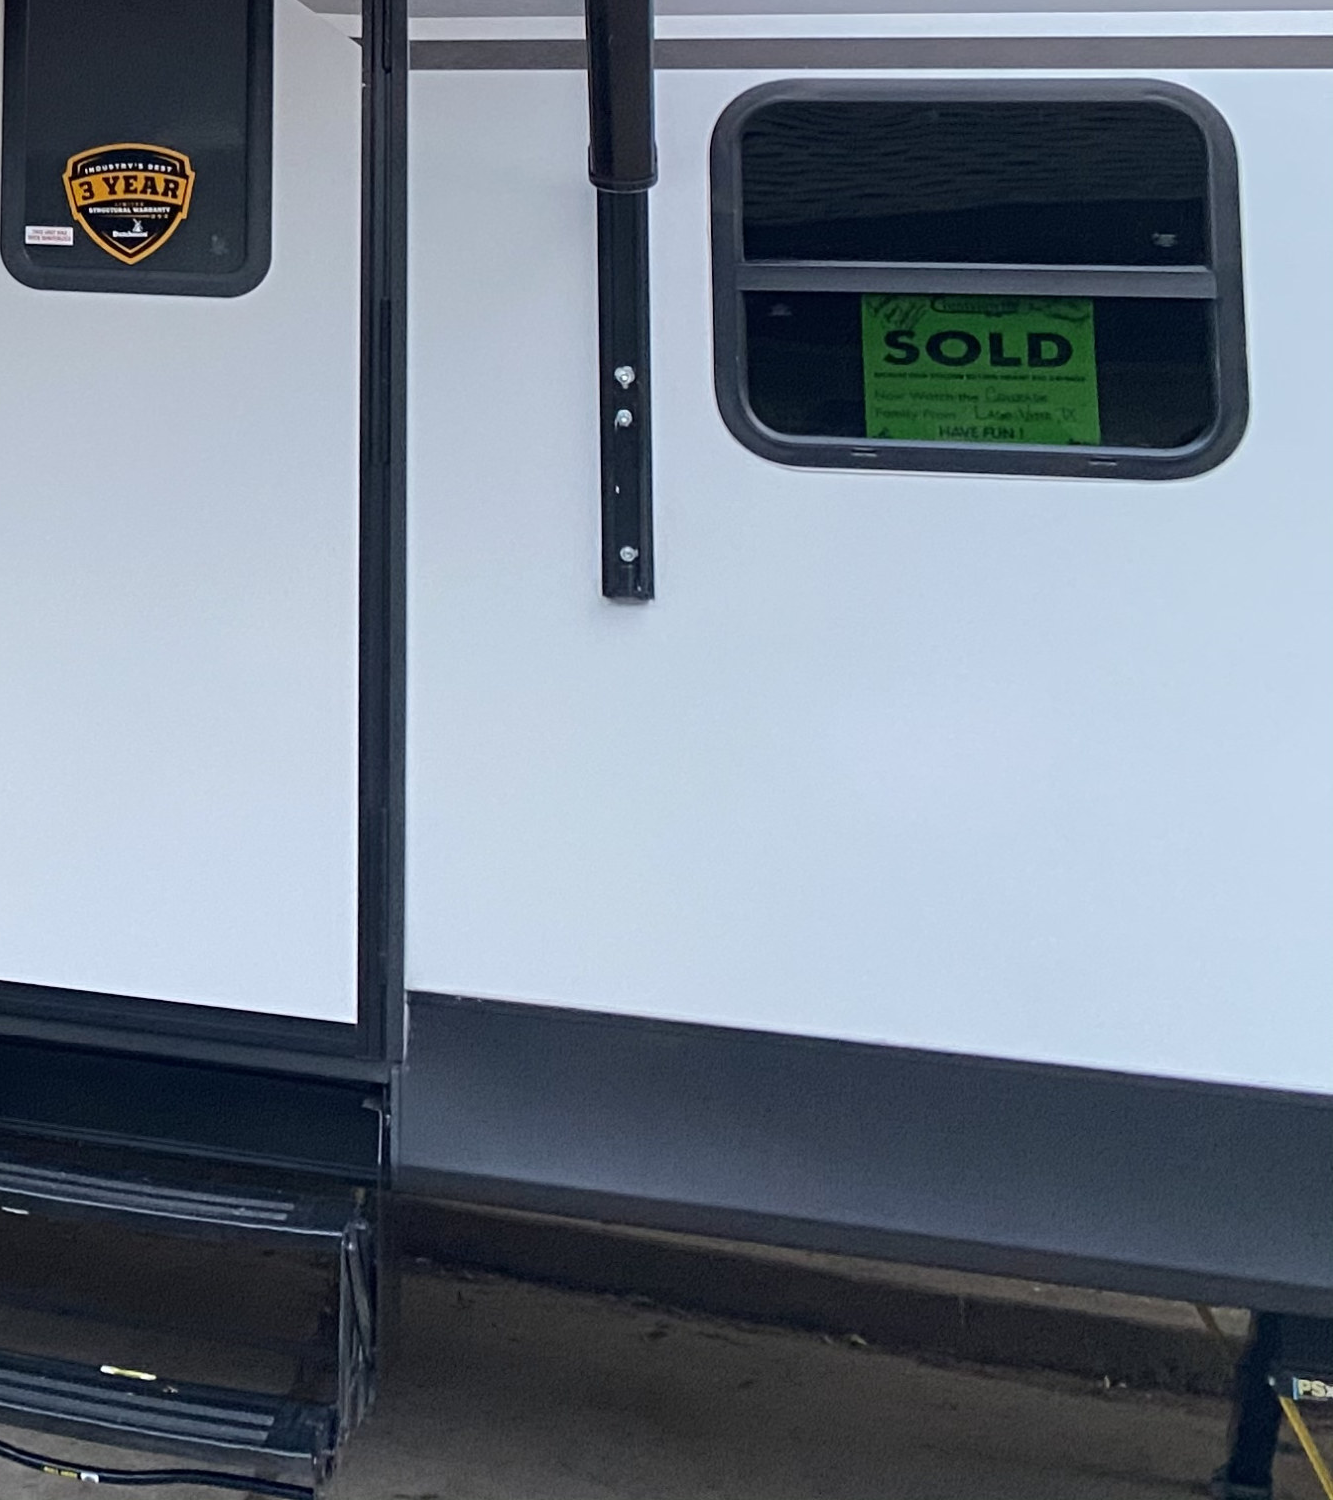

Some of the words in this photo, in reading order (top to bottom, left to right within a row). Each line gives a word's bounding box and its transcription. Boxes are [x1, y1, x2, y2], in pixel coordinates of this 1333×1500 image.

[84, 162, 144, 175] INDUSTRY'S
[148, 163, 173, 173] BEST
[78, 181, 95, 201] 3
[102, 175, 180, 199] YEAR
[883, 330, 1073, 368] SOLD
[938, 425, 980, 439] HAVE
[983, 426, 1015, 440] FUN
